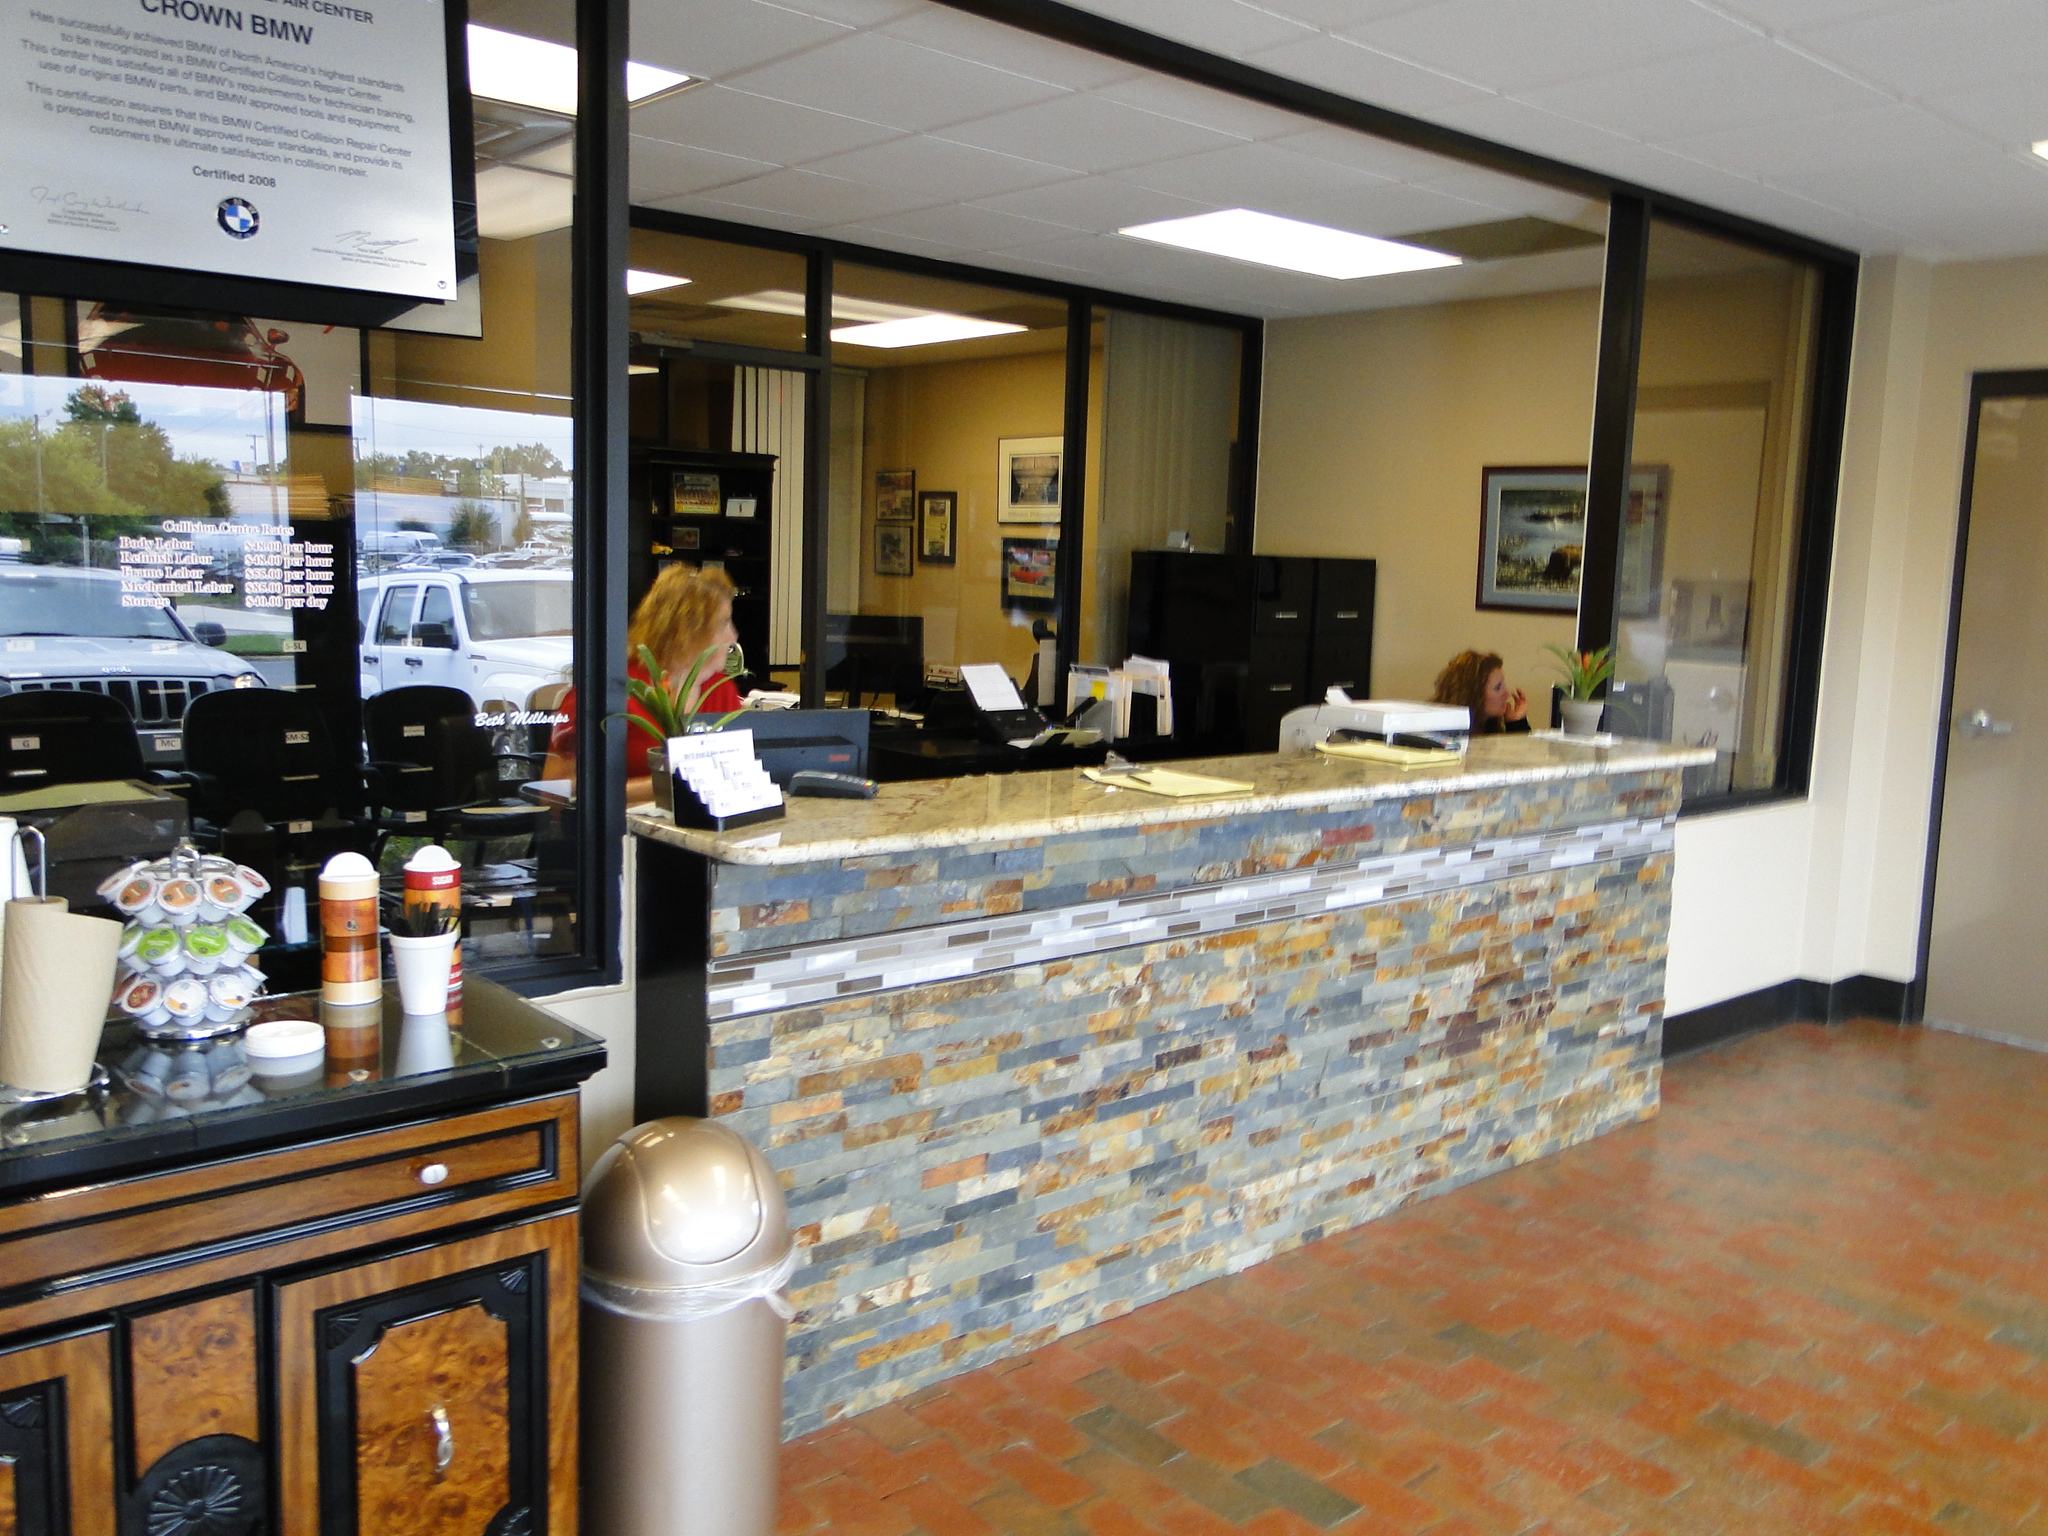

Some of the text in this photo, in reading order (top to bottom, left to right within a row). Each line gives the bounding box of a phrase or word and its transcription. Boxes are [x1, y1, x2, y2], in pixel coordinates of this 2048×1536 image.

[312, 1, 374, 24] CENTER
[140, 0, 313, 45] CROWN BMW
[26, 81, 412, 158] This certification assures that this BMW Certified Collision Repair Center
[43, 101, 403, 170] is prepared to meet BMW approved repair standards, and provide its
[89, 125, 369, 178] customers the ultimate satisfaction in collision repair.
[192, 165, 277, 188] Certified 2008
[162, 519, 295, 537] Collision Centre Rates
[119, 536, 195, 552] Body Labor
[244, 541, 334, 556] $48.00 per hour
[120, 551, 214, 566] Refinish Labor
[244, 554, 334, 570] $48.00 per hour
[120, 566, 205, 580] Frame Labor
[121, 580, 234, 594] Mechanical Labor
[122, 595, 170, 609] Storage
[474, 711, 570, 727] Beth Millsaps
[22, 739, 30, 748] G
[431, 874, 454, 886] SUGAR
